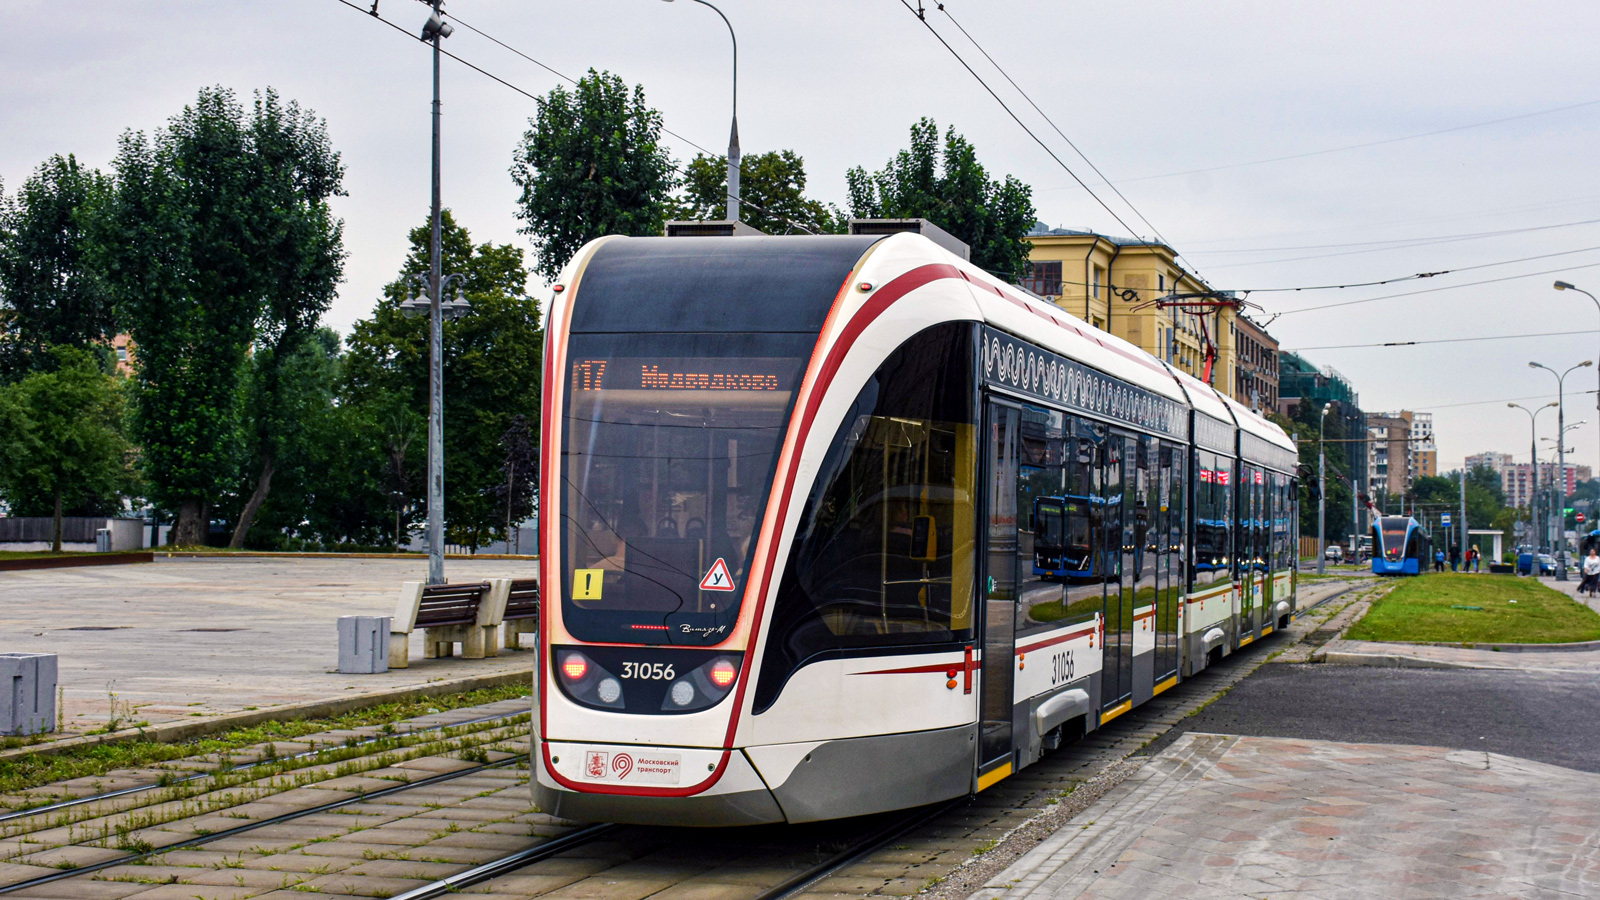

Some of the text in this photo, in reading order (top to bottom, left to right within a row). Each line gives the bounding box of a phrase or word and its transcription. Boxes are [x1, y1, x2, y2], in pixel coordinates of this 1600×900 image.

[621, 661, 675, 680] 31056
[1052, 650, 1074, 684] 31056
[637, 758, 679, 766] Московский
[637, 766, 671, 774] транспорт
